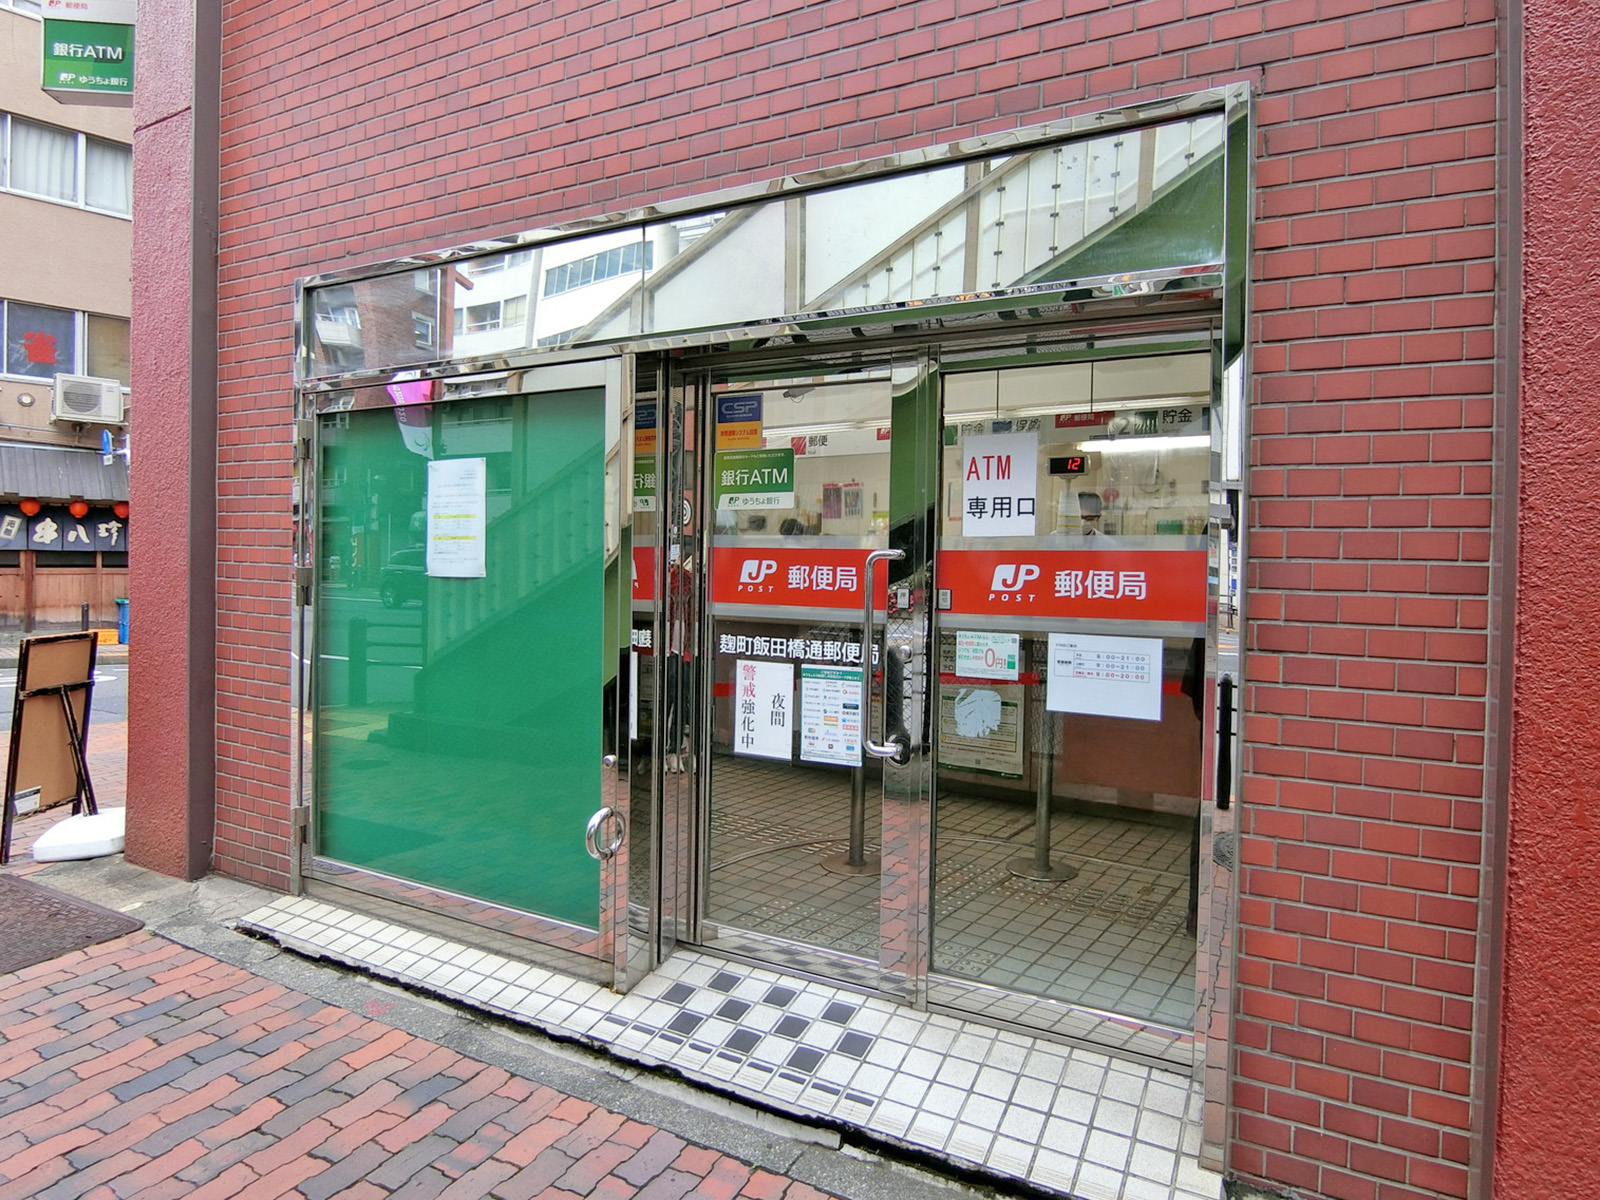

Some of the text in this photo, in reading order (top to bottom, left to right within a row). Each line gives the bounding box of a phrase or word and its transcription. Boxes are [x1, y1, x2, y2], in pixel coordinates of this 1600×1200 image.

[53, 42, 123, 60] 銀行ATM
[78, 75, 128, 87] ゆうちょ銀行
[721, 400, 758, 414] CSP
[1162, 408, 1193, 424] 貯金
[1118, 417, 1130, 436] 2
[808, 435, 828, 447] 郵便
[966, 455, 1011, 481] ATM
[1066, 457, 1081, 470] 12
[721, 468, 788, 486] 銀行ATM
[742, 496, 780, 506] ゆうちょ銀行
[966, 496, 1035, 519] 専用口
[740, 560, 858, 592] JP 郵便局
[990, 563, 1147, 600] JP 郵便局
[988, 593, 1037, 602] POST
[741, 664, 757, 750] 警戒強化中
[771, 694, 786, 728] 夜間
